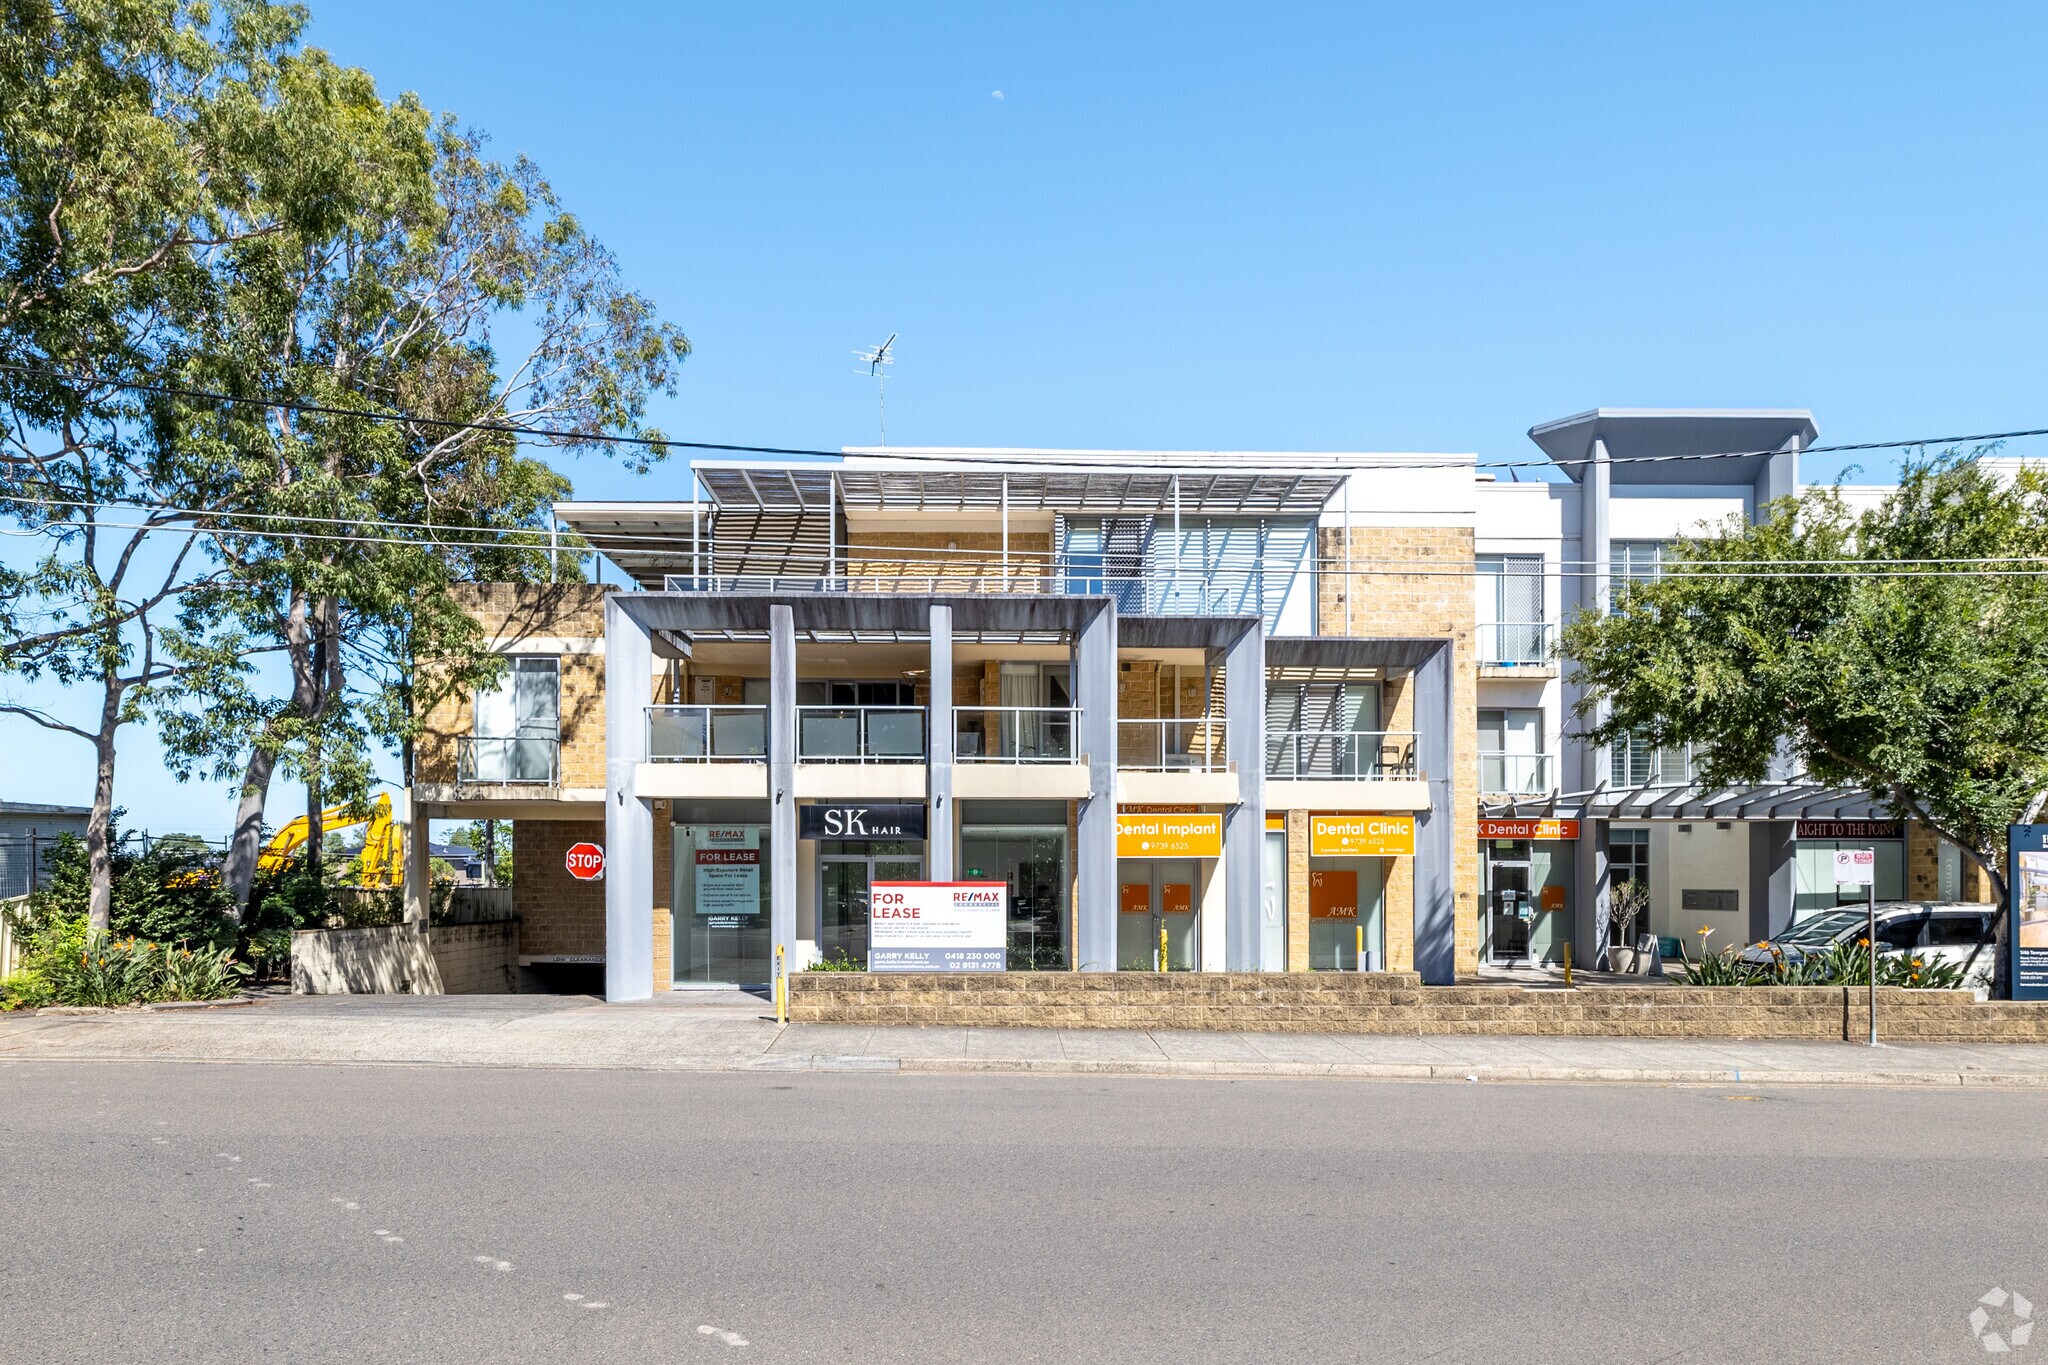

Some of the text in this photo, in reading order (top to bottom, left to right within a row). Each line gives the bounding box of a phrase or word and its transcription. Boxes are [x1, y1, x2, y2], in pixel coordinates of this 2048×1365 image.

[824, 809, 902, 836] SK HAIR
[1116, 823, 1216, 838] Dental Implant
[1317, 822, 1409, 835] Dental Clinic
[1488, 824, 1529, 834] Dental
[1532, 824, 1568, 834] Clinic
[1797, 823, 1828, 836] AIGHT
[1830, 823, 1844, 836] TO
[1846, 823, 1865, 836] THE
[568, 854, 602, 868] STOP
[700, 853, 756, 861] FOR LEASE
[873, 894, 904, 904] FOR
[953, 892, 999, 901] RE/MAX
[873, 908, 920, 918] LEASE
[1327, 906, 1357, 917] AMK
